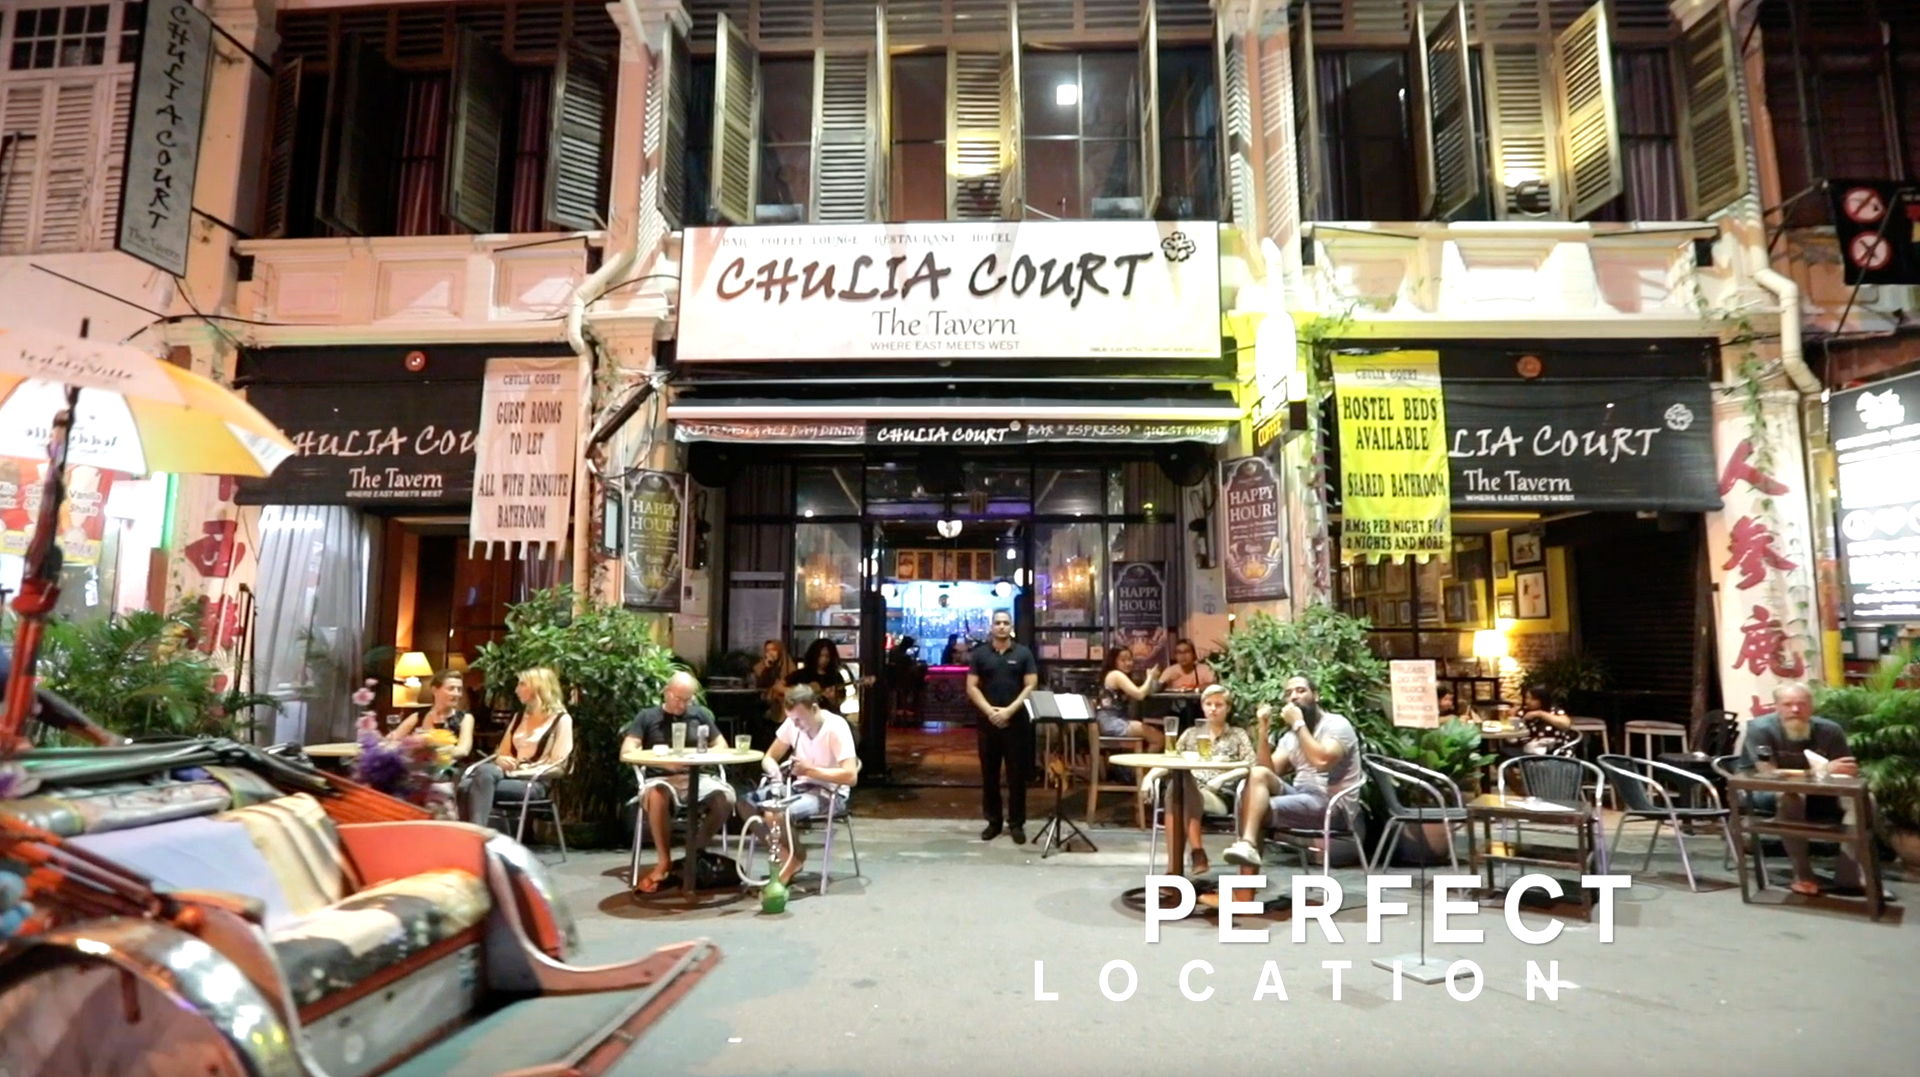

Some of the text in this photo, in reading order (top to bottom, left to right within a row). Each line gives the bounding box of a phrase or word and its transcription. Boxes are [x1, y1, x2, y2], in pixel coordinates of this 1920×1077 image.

[156, 5, 191, 125] CHULIA
[148, 130, 176, 230] COURT
[722, 233, 1012, 248] BAR COFFEE LOUNGE RESTAURANT HOTEL
[716, 251, 1154, 309] CHULIA COURT
[871, 307, 1018, 336] The Tavern
[870, 340, 1020, 351] WHERE EAST MEETS WEST
[534, 373, 561, 384] COURT
[496, 401, 563, 425] GUEST ROOMS
[1343, 396, 1438, 421] HOSTEL BEDS
[282, 427, 408, 457] HULIA
[414, 425, 479, 455] COU
[789, 425, 818, 439] DAY
[818, 426, 865, 440] DINING
[876, 426, 1009, 445] CHULIA COURT
[1026, 424, 1055, 437] BAR
[1065, 425, 1132, 438] ESPRESSO
[1142, 425, 1183, 438] GUEST
[1355, 427, 1430, 450] AVAILABLE
[510, 432, 545, 455] TO LET
[1532, 424, 1663, 464] COURT
[348, 465, 443, 489] The Tavern
[478, 473, 569, 497] ALL WITH ENSUITE
[1347, 472, 1446, 497] SHARED BATHROOM
[1463, 467, 1573, 492] The Tavern
[373, 490, 394, 498] EAST
[1229, 484, 1275, 506] HAPPY
[497, 504, 547, 529] BATHROOM
[631, 499, 678, 518] HAPPY
[1230, 502, 1277, 522] HOUR!
[630, 515, 679, 533] HOUR!
[1373, 519, 1392, 535] PER
[1392, 519, 1425, 534] NIGHT
[1353, 536, 1393, 550] NIGHTS
[1394, 535, 1417, 549] AND
[1418, 535, 1445, 549] MORE
[1120, 586, 1160, 598] HAPPY
[1120, 600, 1161, 612] HOUR!
